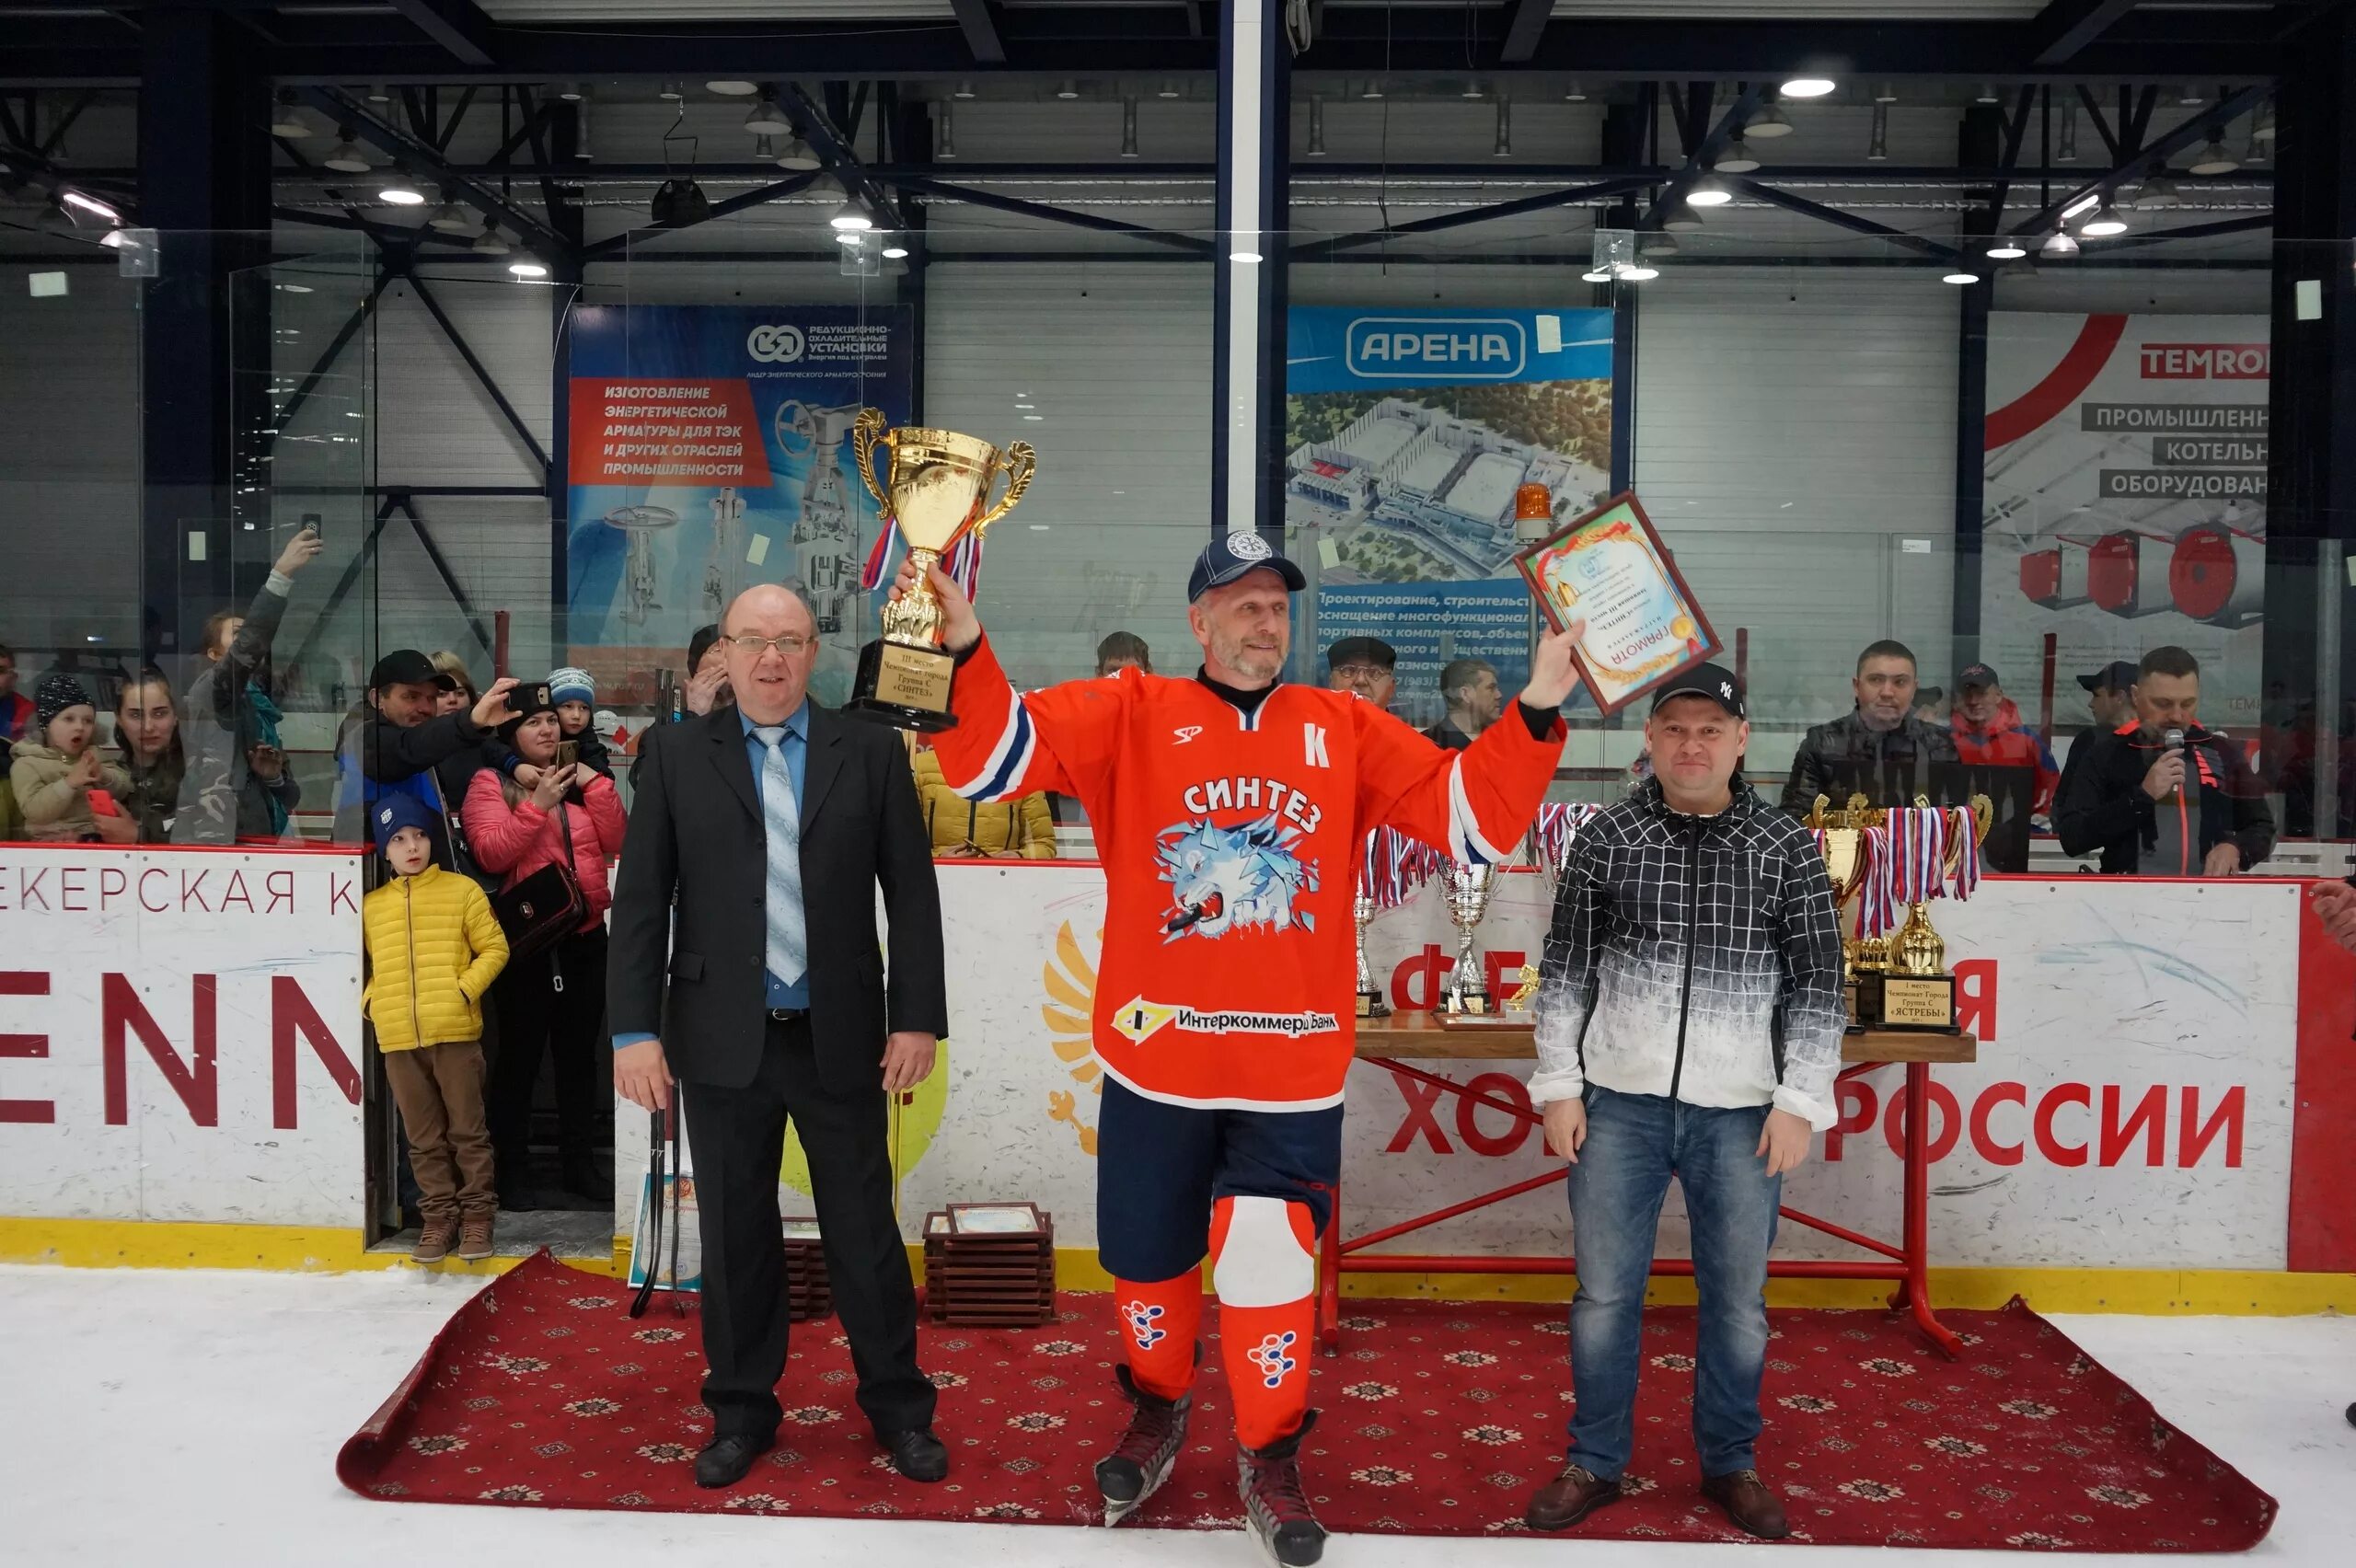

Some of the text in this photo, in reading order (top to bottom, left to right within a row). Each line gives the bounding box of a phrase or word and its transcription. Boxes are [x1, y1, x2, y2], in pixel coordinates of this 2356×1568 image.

[809, 343, 887, 353] УСТАНОВКИ
[1360, 333, 1511, 363] АРЕНА
[604, 386, 710, 398] ИЗГОТОВЛЕНИЕ
[604, 404, 728, 418] ЭНЕРГЕТИЧЕСКОЙ
[603, 424, 743, 439] АРМАТУРЫ ДЛЯ ТЭК
[603, 443, 744, 457] И ДРУГИХ ОТРАСЛЕЙ
[603, 463, 744, 476] ПРОМЫШЛЕННОСТИ
[1611, 625, 1669, 664] ГРАМОТА
[1303, 722, 1331, 768] К
[1184, 776, 1322, 836] СИНТЕЗ
[1887, 989, 1949, 999] Чемпионат Города
[1902, 999, 1927, 1008] Группа
[1824, 1080, 2246, 1169] РОССИИ
